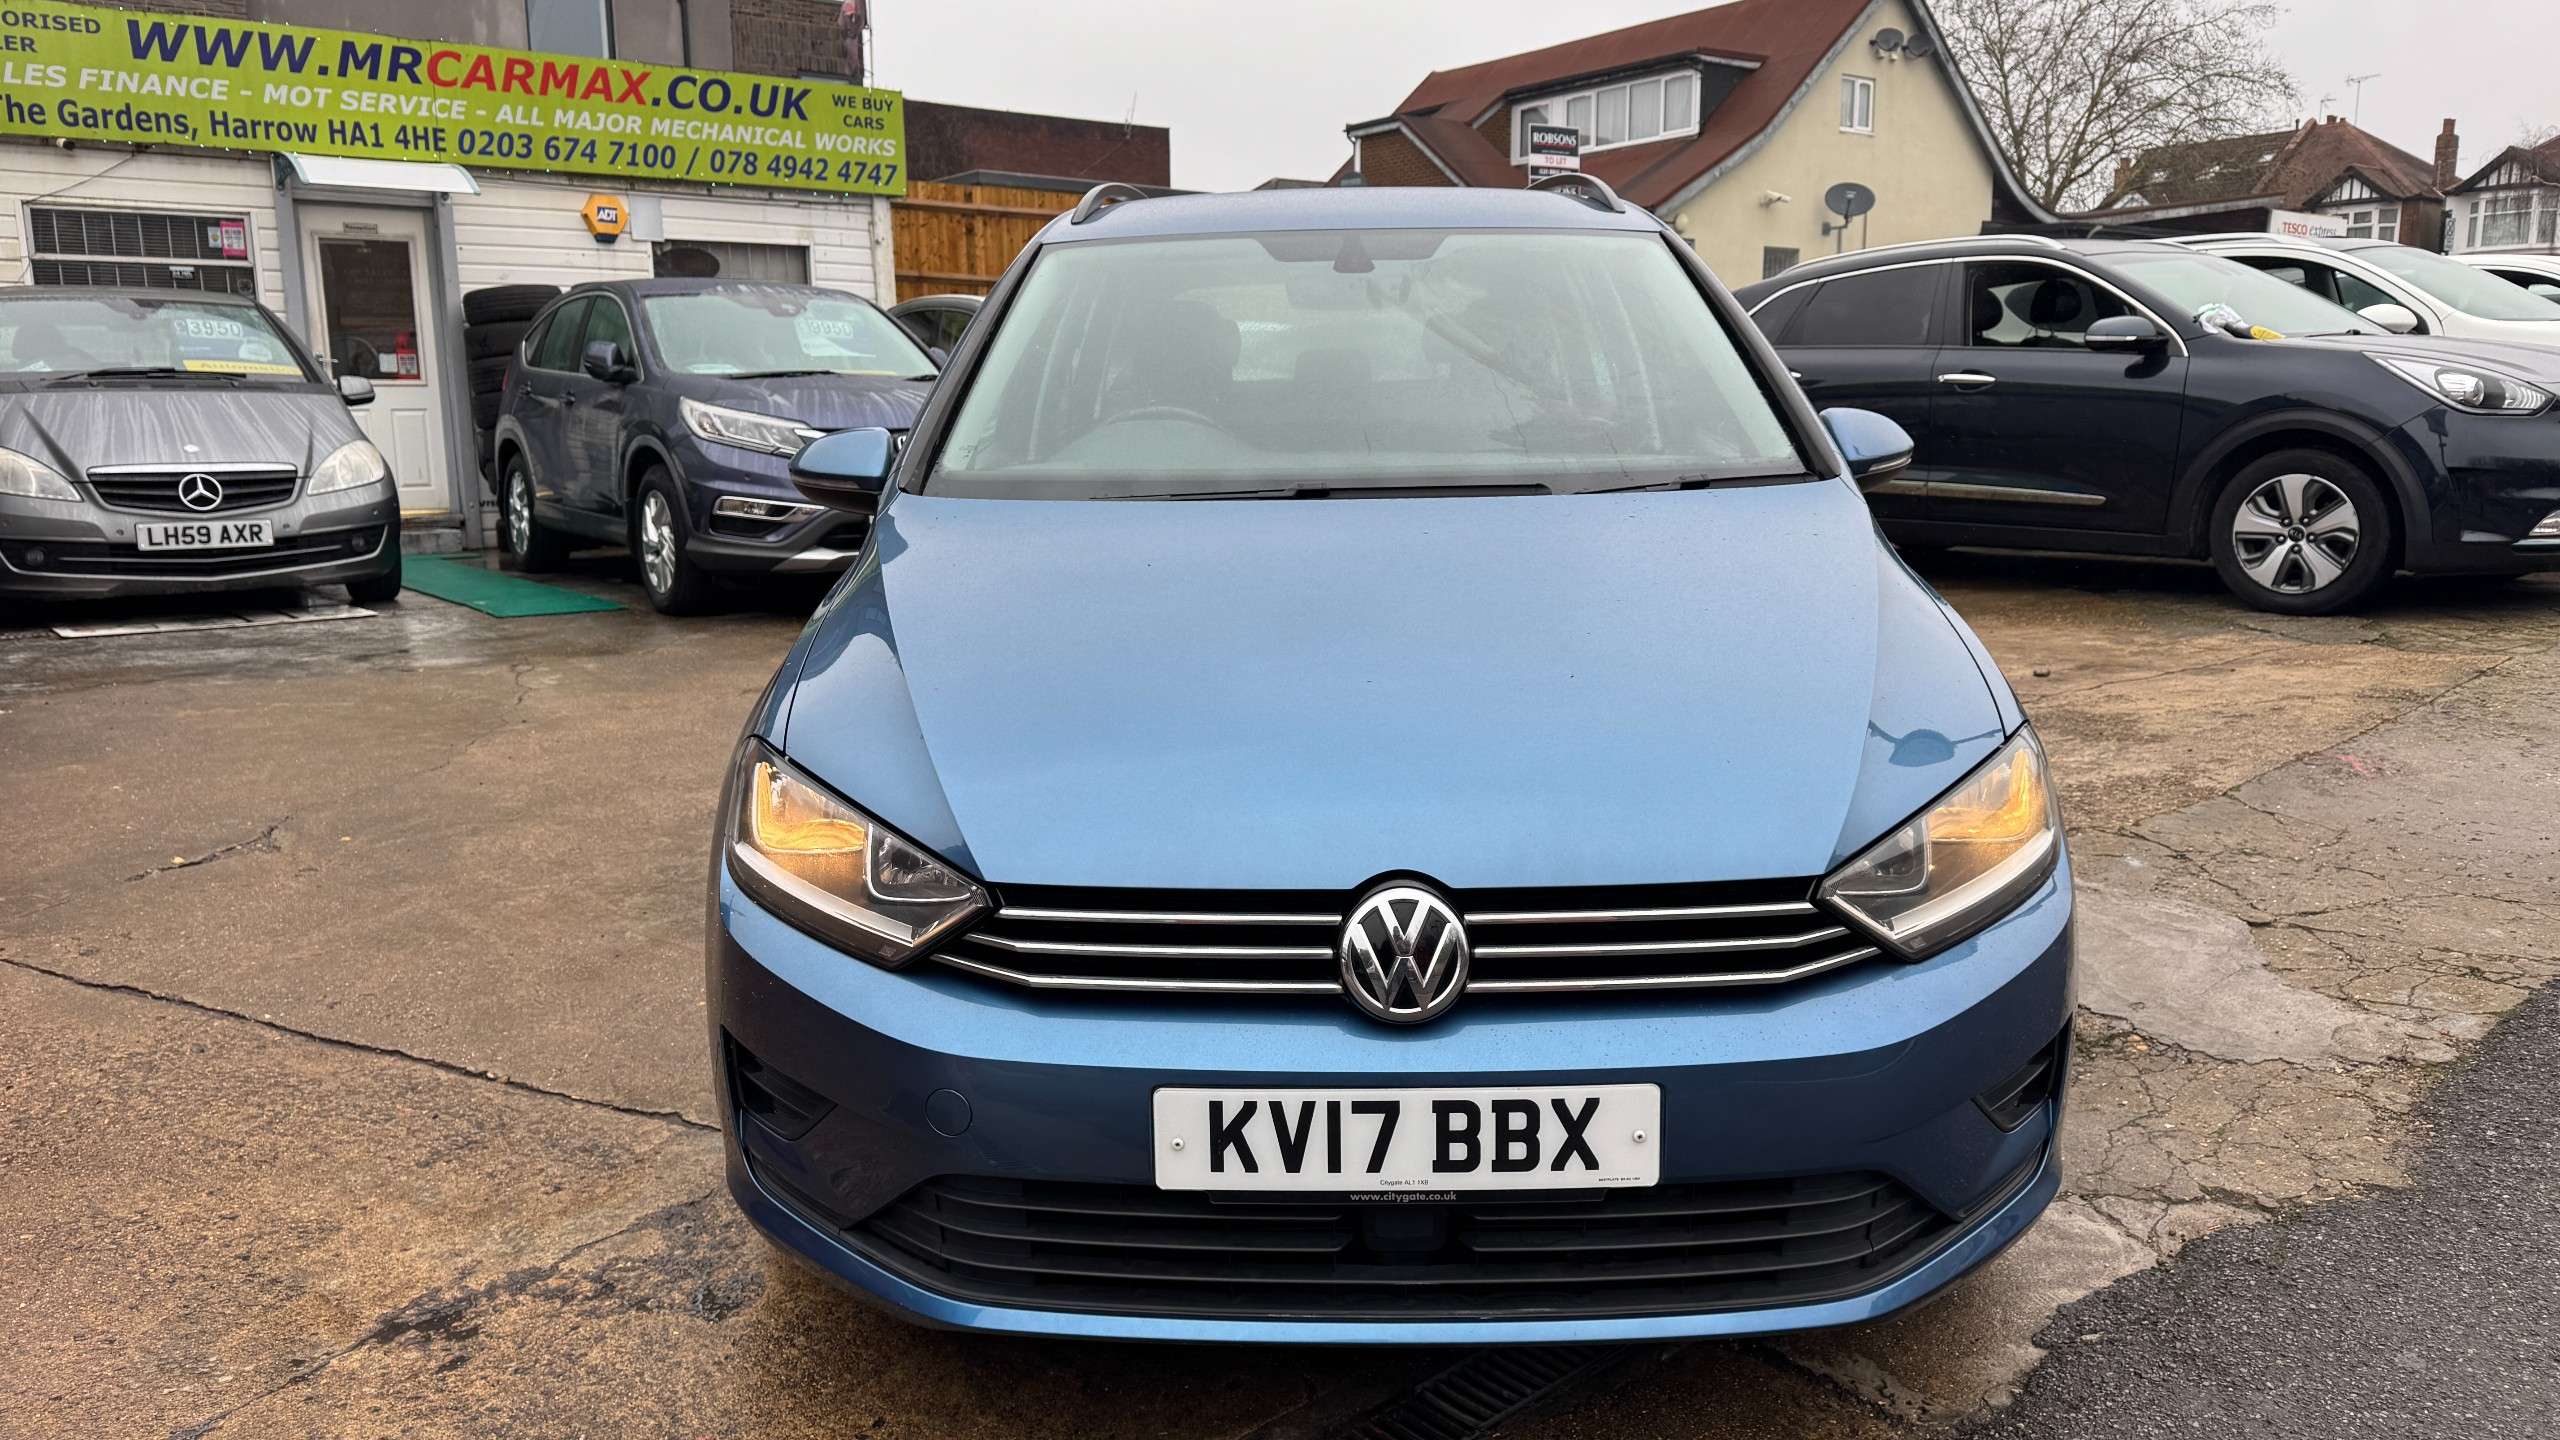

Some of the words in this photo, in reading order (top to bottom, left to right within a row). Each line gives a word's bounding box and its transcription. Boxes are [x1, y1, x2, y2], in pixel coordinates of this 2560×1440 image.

[1, 10, 102, 34] ORISED
[0, 35, 38, 53] ER
[126, 18, 812, 121] WWW.MRCARMAX.CO.UK
[3, 61, 67, 88] LES
[79, 67, 230, 101] FINANCE
[263, 83, 333, 109] MOT
[340, 89, 468, 120] SERVICE
[495, 104, 545, 127] ALL
[554, 108, 643, 134] MAJOR
[650, 117, 807, 149] MECHANICAL
[815, 132, 897, 157] WORKS
[831, 94, 857, 109] WE
[862, 97, 894, 113] BUY
[843, 114, 885, 130] CARS
[0, 93, 47, 126] he
[57, 98, 198, 141] Gardens,
[209, 110, 318, 143] Harrow
[328, 119, 385, 148] HA1
[394, 124, 448, 153] 4HE
[458, 128, 534, 159] 0203
[543, 135, 598, 164] 674
[607, 140, 677, 170] 7100
[709, 149, 758, 176] 078
[767, 154, 829, 181] 4942
[837, 160, 898, 187] 4747
[1532, 131, 1577, 146] ROBSONS
[598, 208, 616, 222] ADT
[2283, 222, 2308, 236] TESCO
[147, 526, 212, 546] LH59
[220, 523, 263, 544] AXR
[1209, 1100, 1400, 1174] KV17
[1432, 1097, 1600, 1174] BBX
[1350, 1190, 1457, 1203] www.citygate.co.uk
